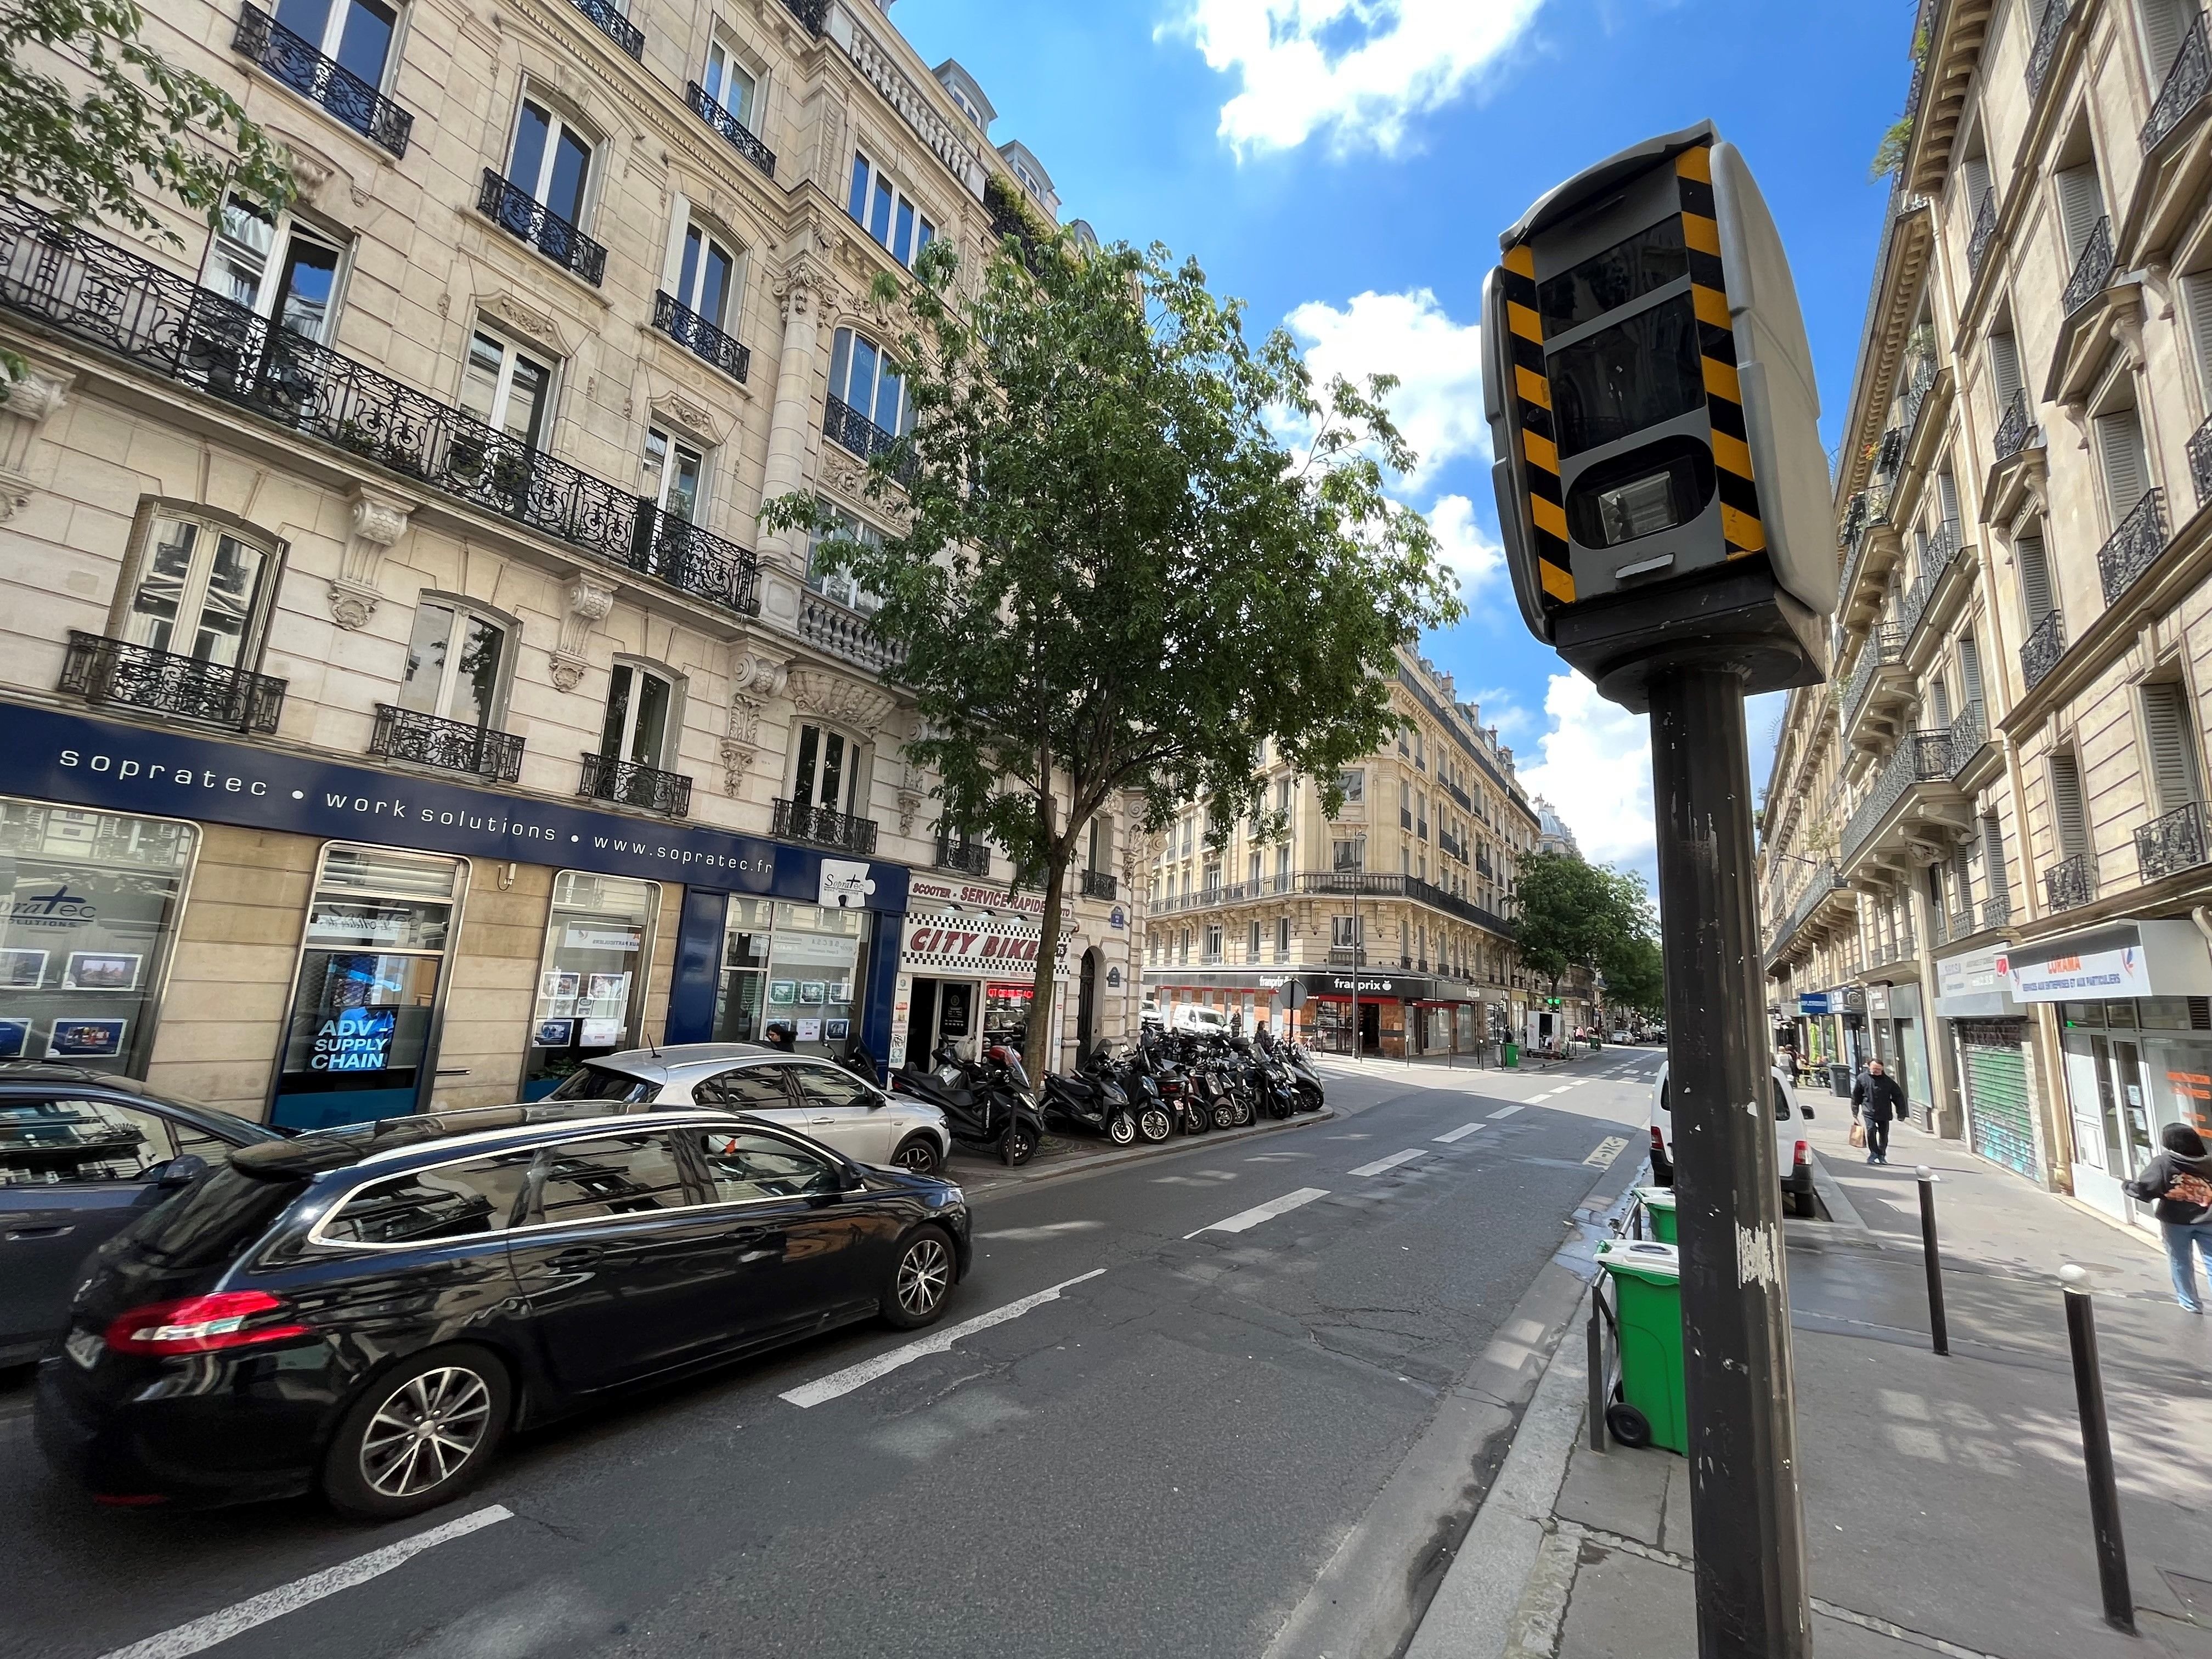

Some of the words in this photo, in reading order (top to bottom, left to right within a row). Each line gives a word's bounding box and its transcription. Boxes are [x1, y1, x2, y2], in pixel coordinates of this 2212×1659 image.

[60, 749, 267, 797] sopratec
[326, 792, 405, 817] work
[421, 808, 555, 841] solutions
[594, 836, 772, 873] www.sopratec.fr
[913, 882, 951, 898] SCOOTER
[960, 887, 1009, 907] SERVICE
[1010, 894, 1045, 913] RAPIDE
[1060, 908, 1070, 917] TO
[9, 918, 76, 928] OLUTIONS
[910, 928, 980, 955] CITY
[980, 935, 1040, 961] BIKE
[318, 1020, 374, 1036] ADV
[314, 1038, 388, 1052] SUPPLY
[311, 1053, 385, 1069] CHAIN
